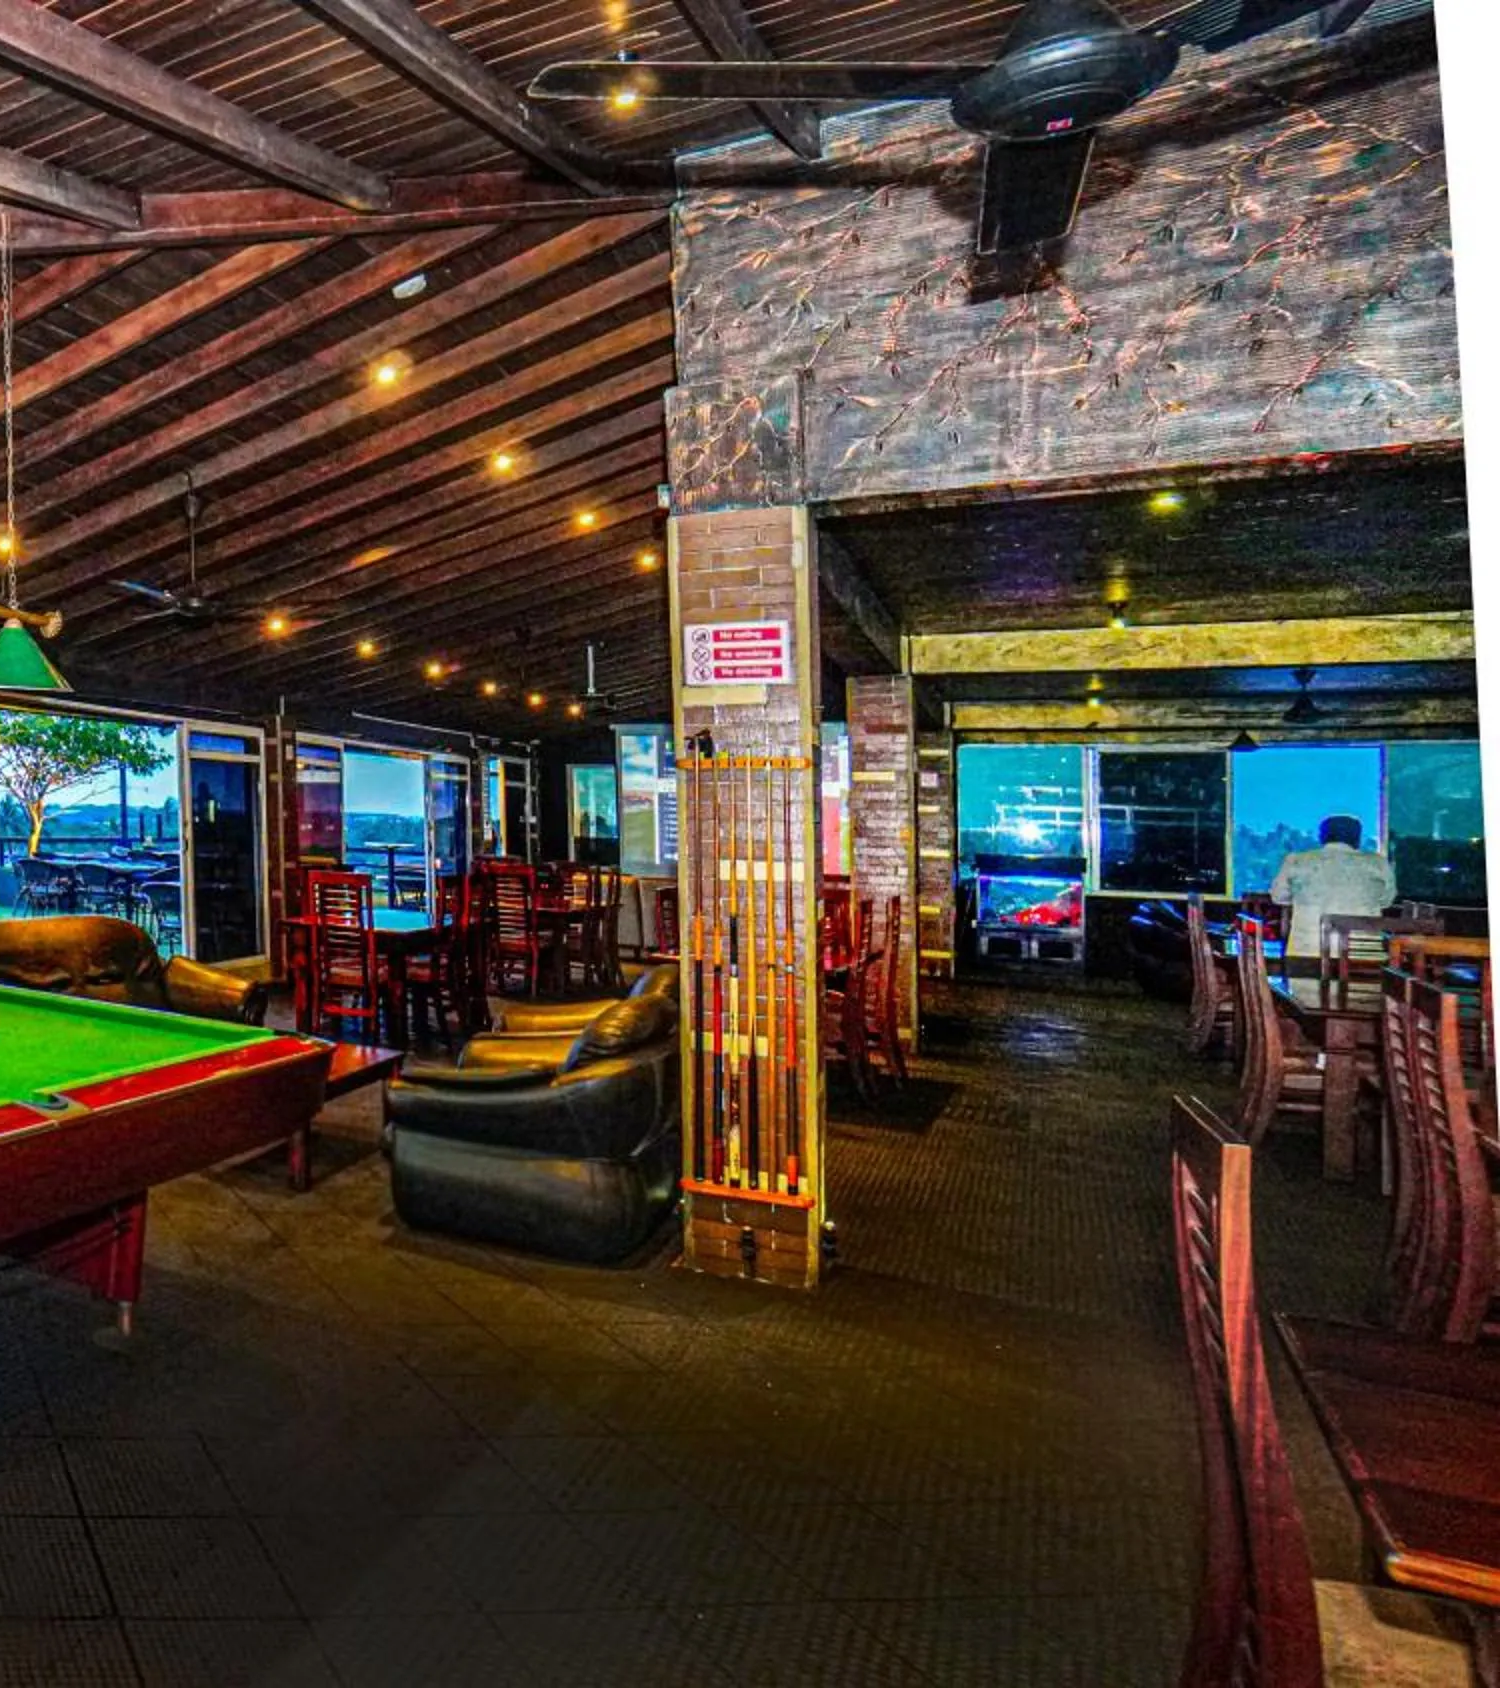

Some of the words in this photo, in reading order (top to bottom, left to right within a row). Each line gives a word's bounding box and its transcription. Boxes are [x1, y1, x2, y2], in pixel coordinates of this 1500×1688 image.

[719, 630, 733, 640] No
[734, 630, 763, 641] eating
[720, 650, 733, 659] No
[735, 648, 773, 660] smoking
[721, 668, 733, 676] No
